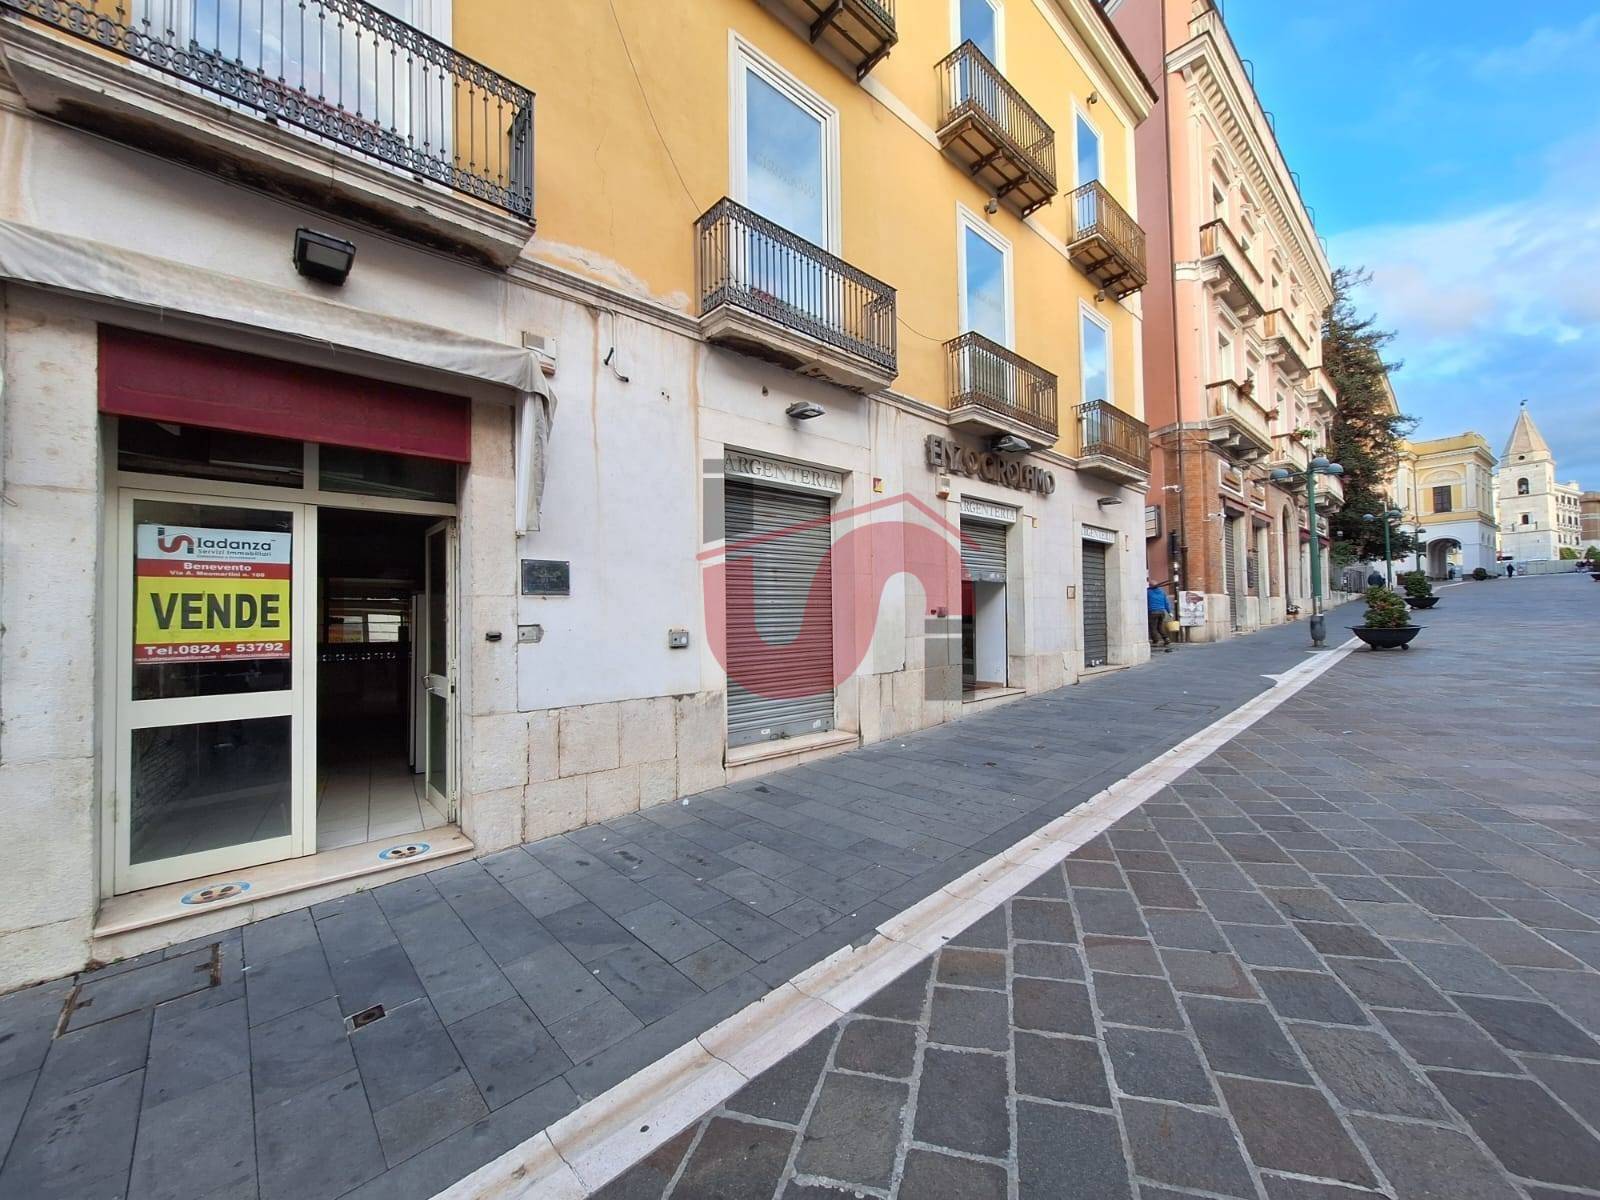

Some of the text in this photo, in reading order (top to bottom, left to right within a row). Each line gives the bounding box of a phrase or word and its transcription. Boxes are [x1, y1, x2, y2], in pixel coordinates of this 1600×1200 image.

[724, 454, 841, 489] ARGENTERIA
[183, 562, 252, 571] Benevento
[150, 592, 281, 630] VENDE
[235, 642, 284, 653] 53792
